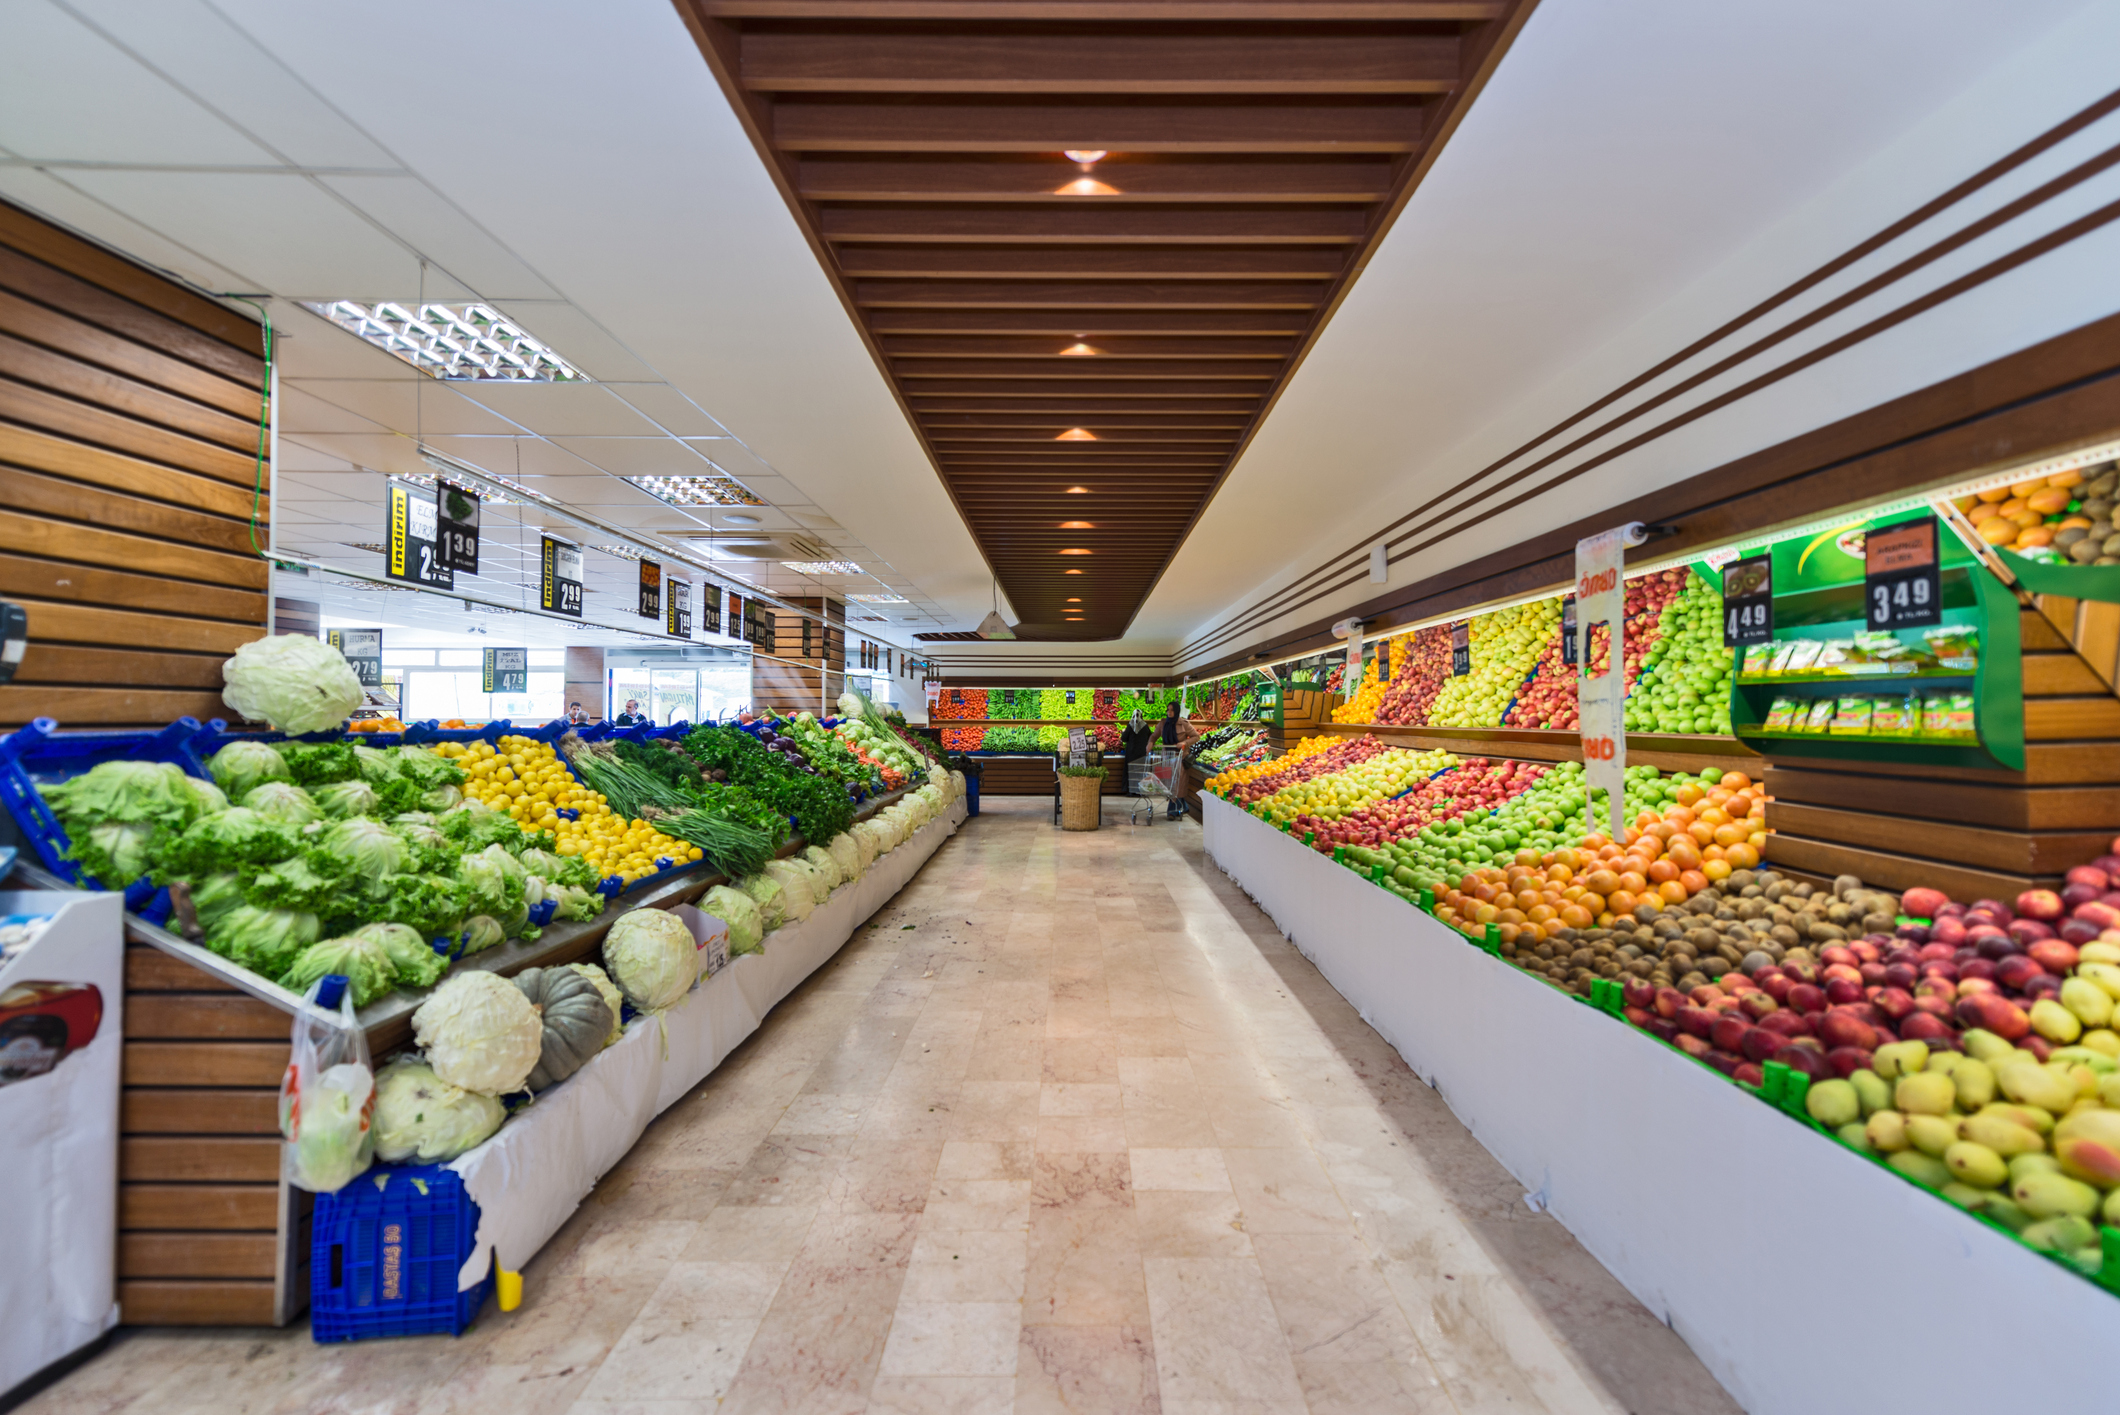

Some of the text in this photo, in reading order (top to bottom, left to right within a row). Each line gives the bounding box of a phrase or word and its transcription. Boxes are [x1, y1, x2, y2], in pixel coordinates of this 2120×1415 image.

[416, 504, 438, 520] ELM
[393, 497, 404, 570] indirim
[443, 530, 475, 563] 139
[561, 583, 580, 610] 299
[642, 592, 659, 614] 299
[1873, 578, 1930, 624] 349
[1727, 604, 1766, 639] 449
[357, 648, 368, 656] KG
[485, 652, 493, 689] indirim
[503, 673, 524, 690] 479
